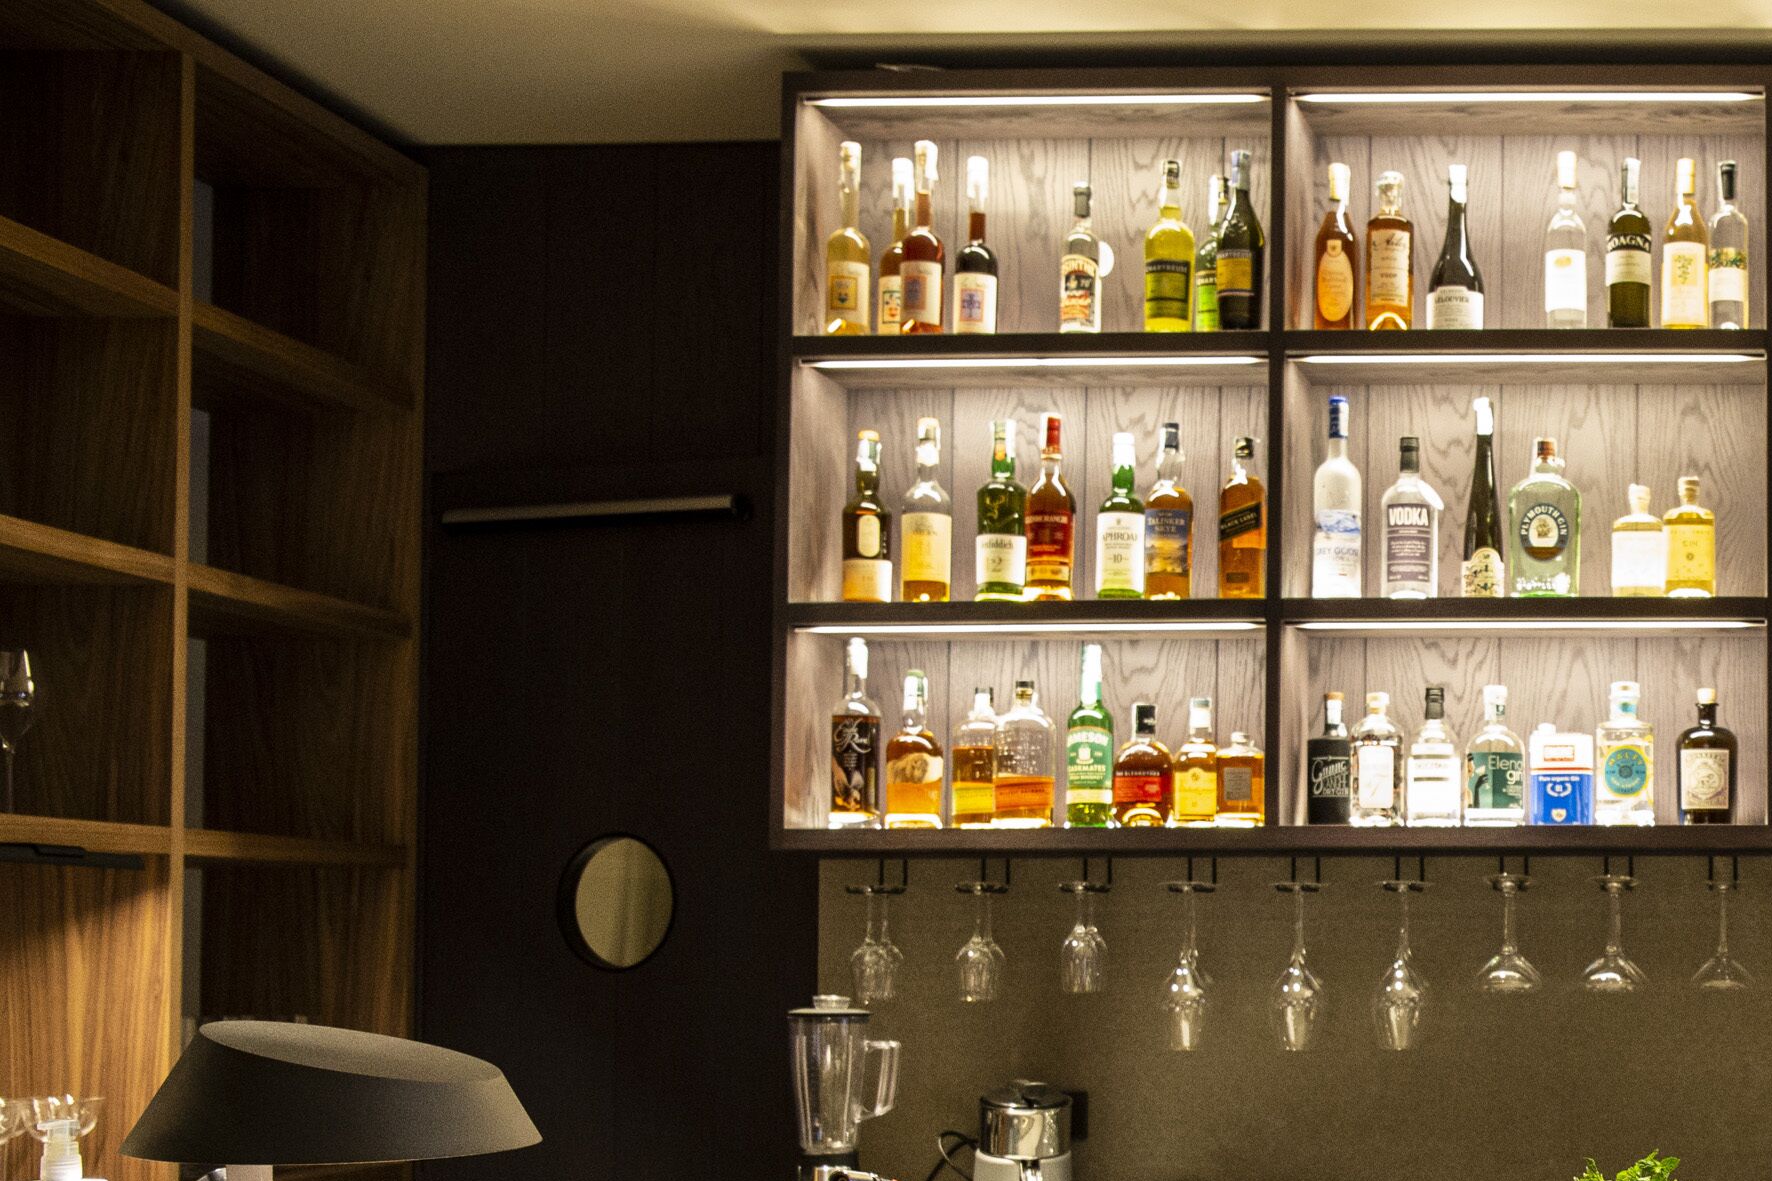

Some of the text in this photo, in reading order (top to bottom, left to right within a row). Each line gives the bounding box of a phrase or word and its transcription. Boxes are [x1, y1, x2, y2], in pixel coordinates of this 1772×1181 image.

[1387, 506, 1429, 527] VODKA
[1519, 505, 1568, 537] PLYMOUTH GIN
